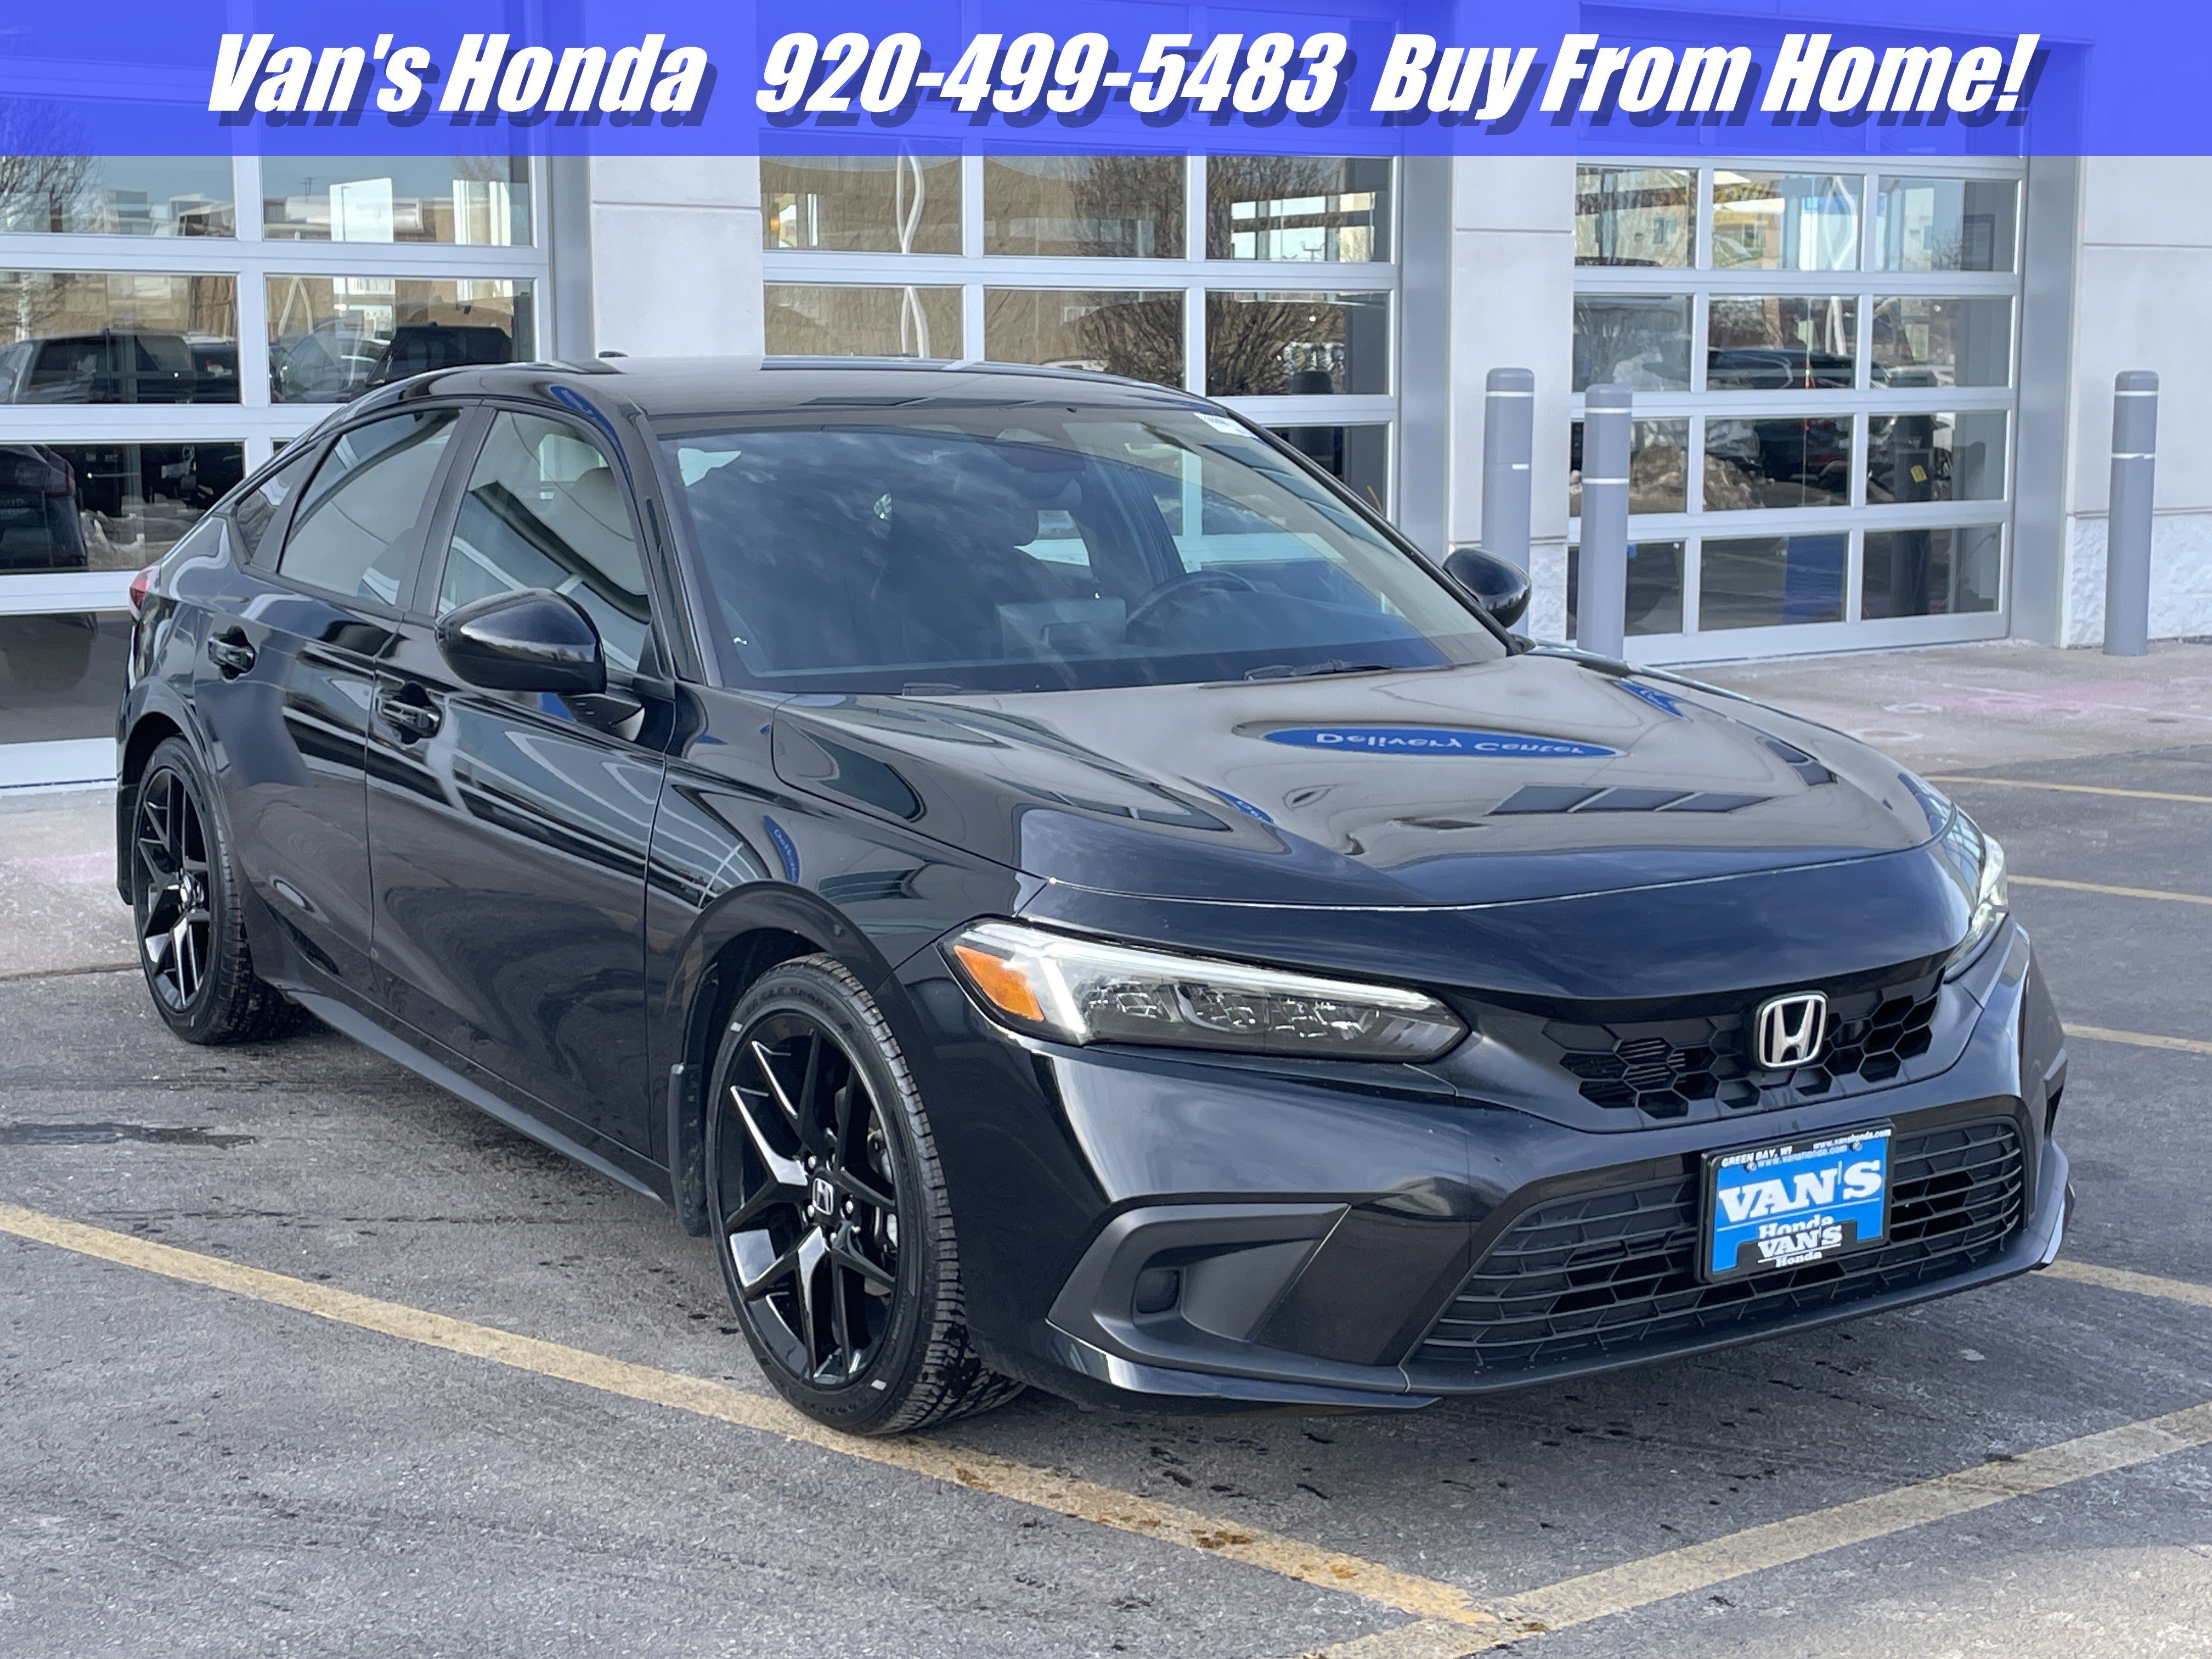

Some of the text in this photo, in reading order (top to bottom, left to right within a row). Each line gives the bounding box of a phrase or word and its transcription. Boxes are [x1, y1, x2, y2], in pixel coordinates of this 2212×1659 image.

[1722, 1146, 1793, 1167] GREEN BAY, WI
[1718, 1160, 1882, 1223] VAN'S
[1759, 1214, 1834, 1239] Honda
[1758, 1225, 1842, 1258] VAN'S
[1775, 1250, 1822, 1268] Honda
